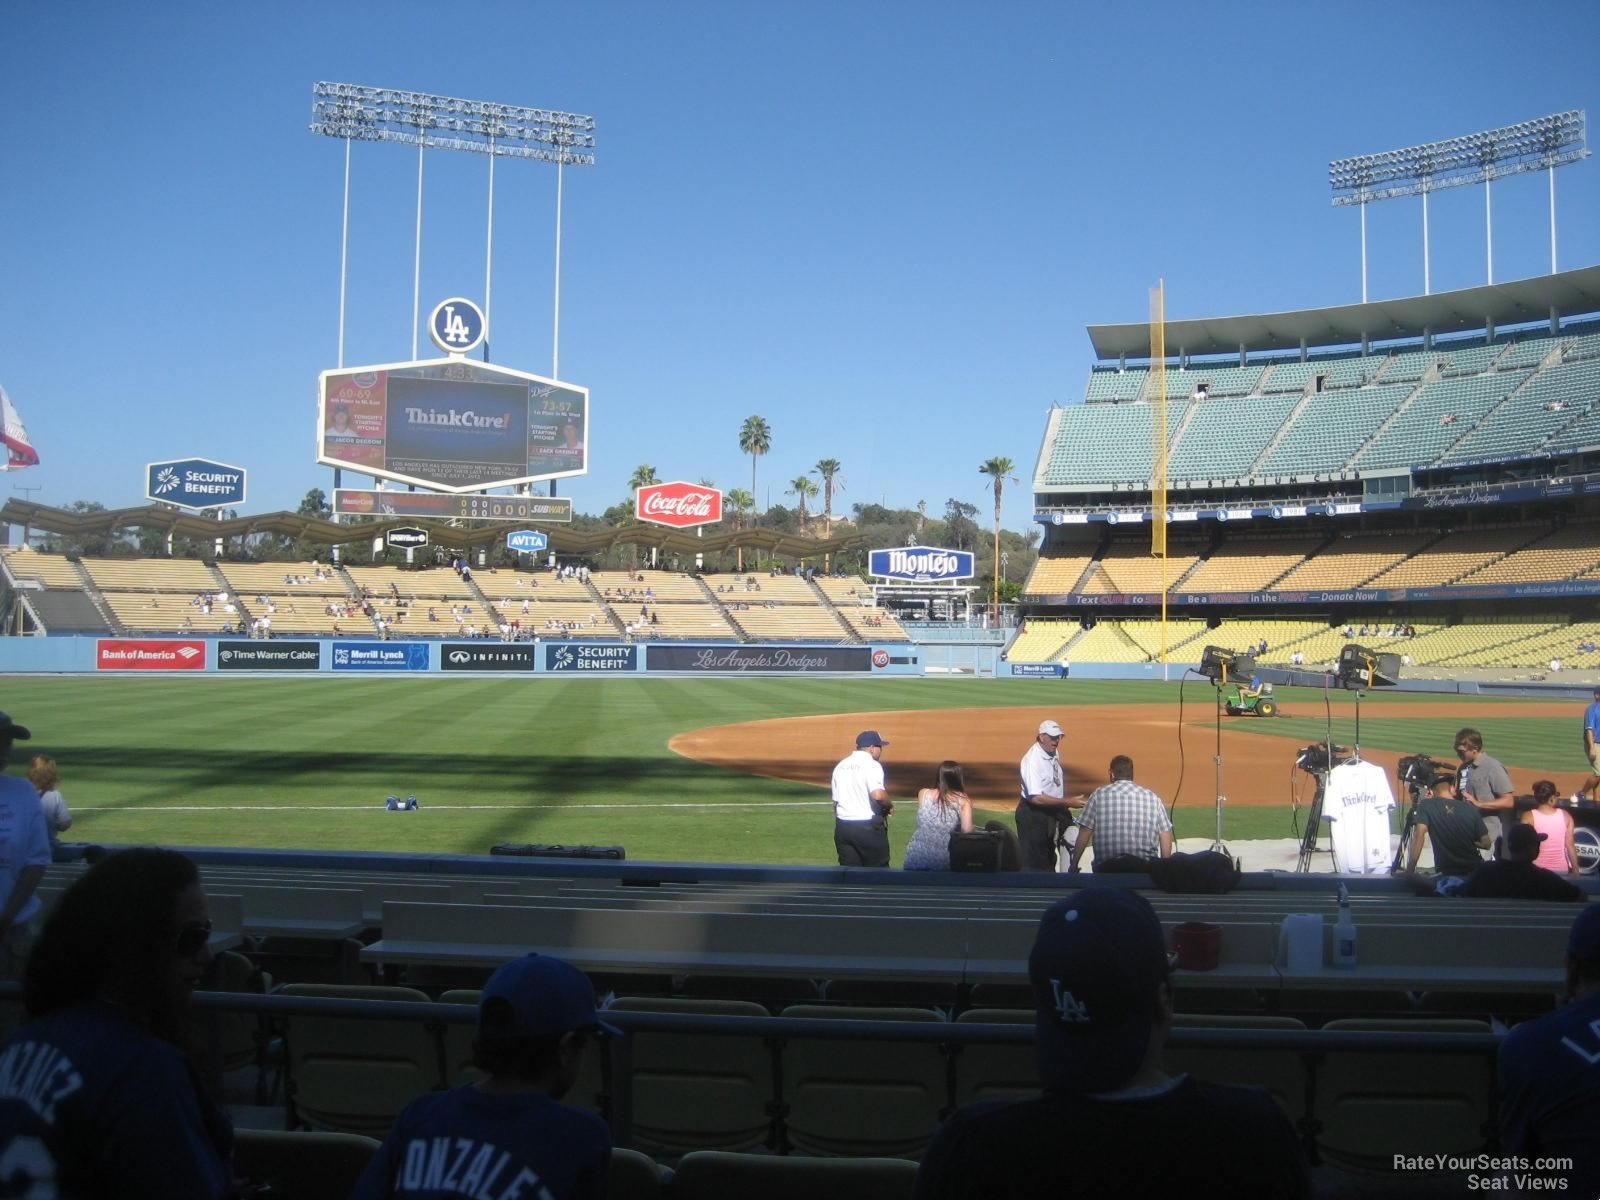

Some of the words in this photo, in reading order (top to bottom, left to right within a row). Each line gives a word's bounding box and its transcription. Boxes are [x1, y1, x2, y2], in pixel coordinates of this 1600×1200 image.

[444, 306, 470, 342] LA
[339, 388, 372, 400] 60-69
[405, 407, 512, 430] ThinkCure!
[186, 470, 239, 484] SECURITY
[1207, 476, 1297, 488] STADIUM
[1313, 470, 1360, 482] CLUB
[185, 482, 232, 495] BENEFIT
[461, 499, 468, 507] 0
[472, 500, 479, 508] 0
[482, 500, 489, 508] 0
[531, 504, 568, 514] SUBWAY
[644, 492, 714, 516] Coca-Cola
[460, 508, 468, 516] 0
[472, 508, 479, 516] 0
[482, 509, 488, 517] 0
[493, 504, 501, 515] 0
[506, 505, 514, 516] 0
[518, 505, 526, 516] 0
[888, 551, 958, 577] Montejo
[1076, 595, 1099, 604] Text
[1132, 595, 1144, 604] to
[1188, 594, 1200, 603] Be
[1251, 594, 1259, 602] in
[1260, 594, 1277, 602] the
[1320, 591, 1354, 601] Donate
[1355, 591, 1378, 601] Now!
[102, 650, 127, 659] Bank
[127, 650, 137, 659] of
[138, 650, 176, 660] America
[232, 650, 256, 659] Time
[256, 651, 290, 660] Warner
[290, 651, 316, 660] Cable
[351, 650, 378, 659] Merrill
[380, 650, 404, 661] Lynch
[473, 653, 528, 661] INFINITI
[578, 647, 631, 657] SECURITY
[577, 658, 625, 669] BENEFIT
[692, 649, 717, 669] Los
[718, 649, 772, 671] Angeles
[772, 649, 828, 671] Dodgers
[874, 653, 888, 665] 76
[1575, 845, 1600, 856] SSAN
[1049, 977, 1091, 1024] LA
